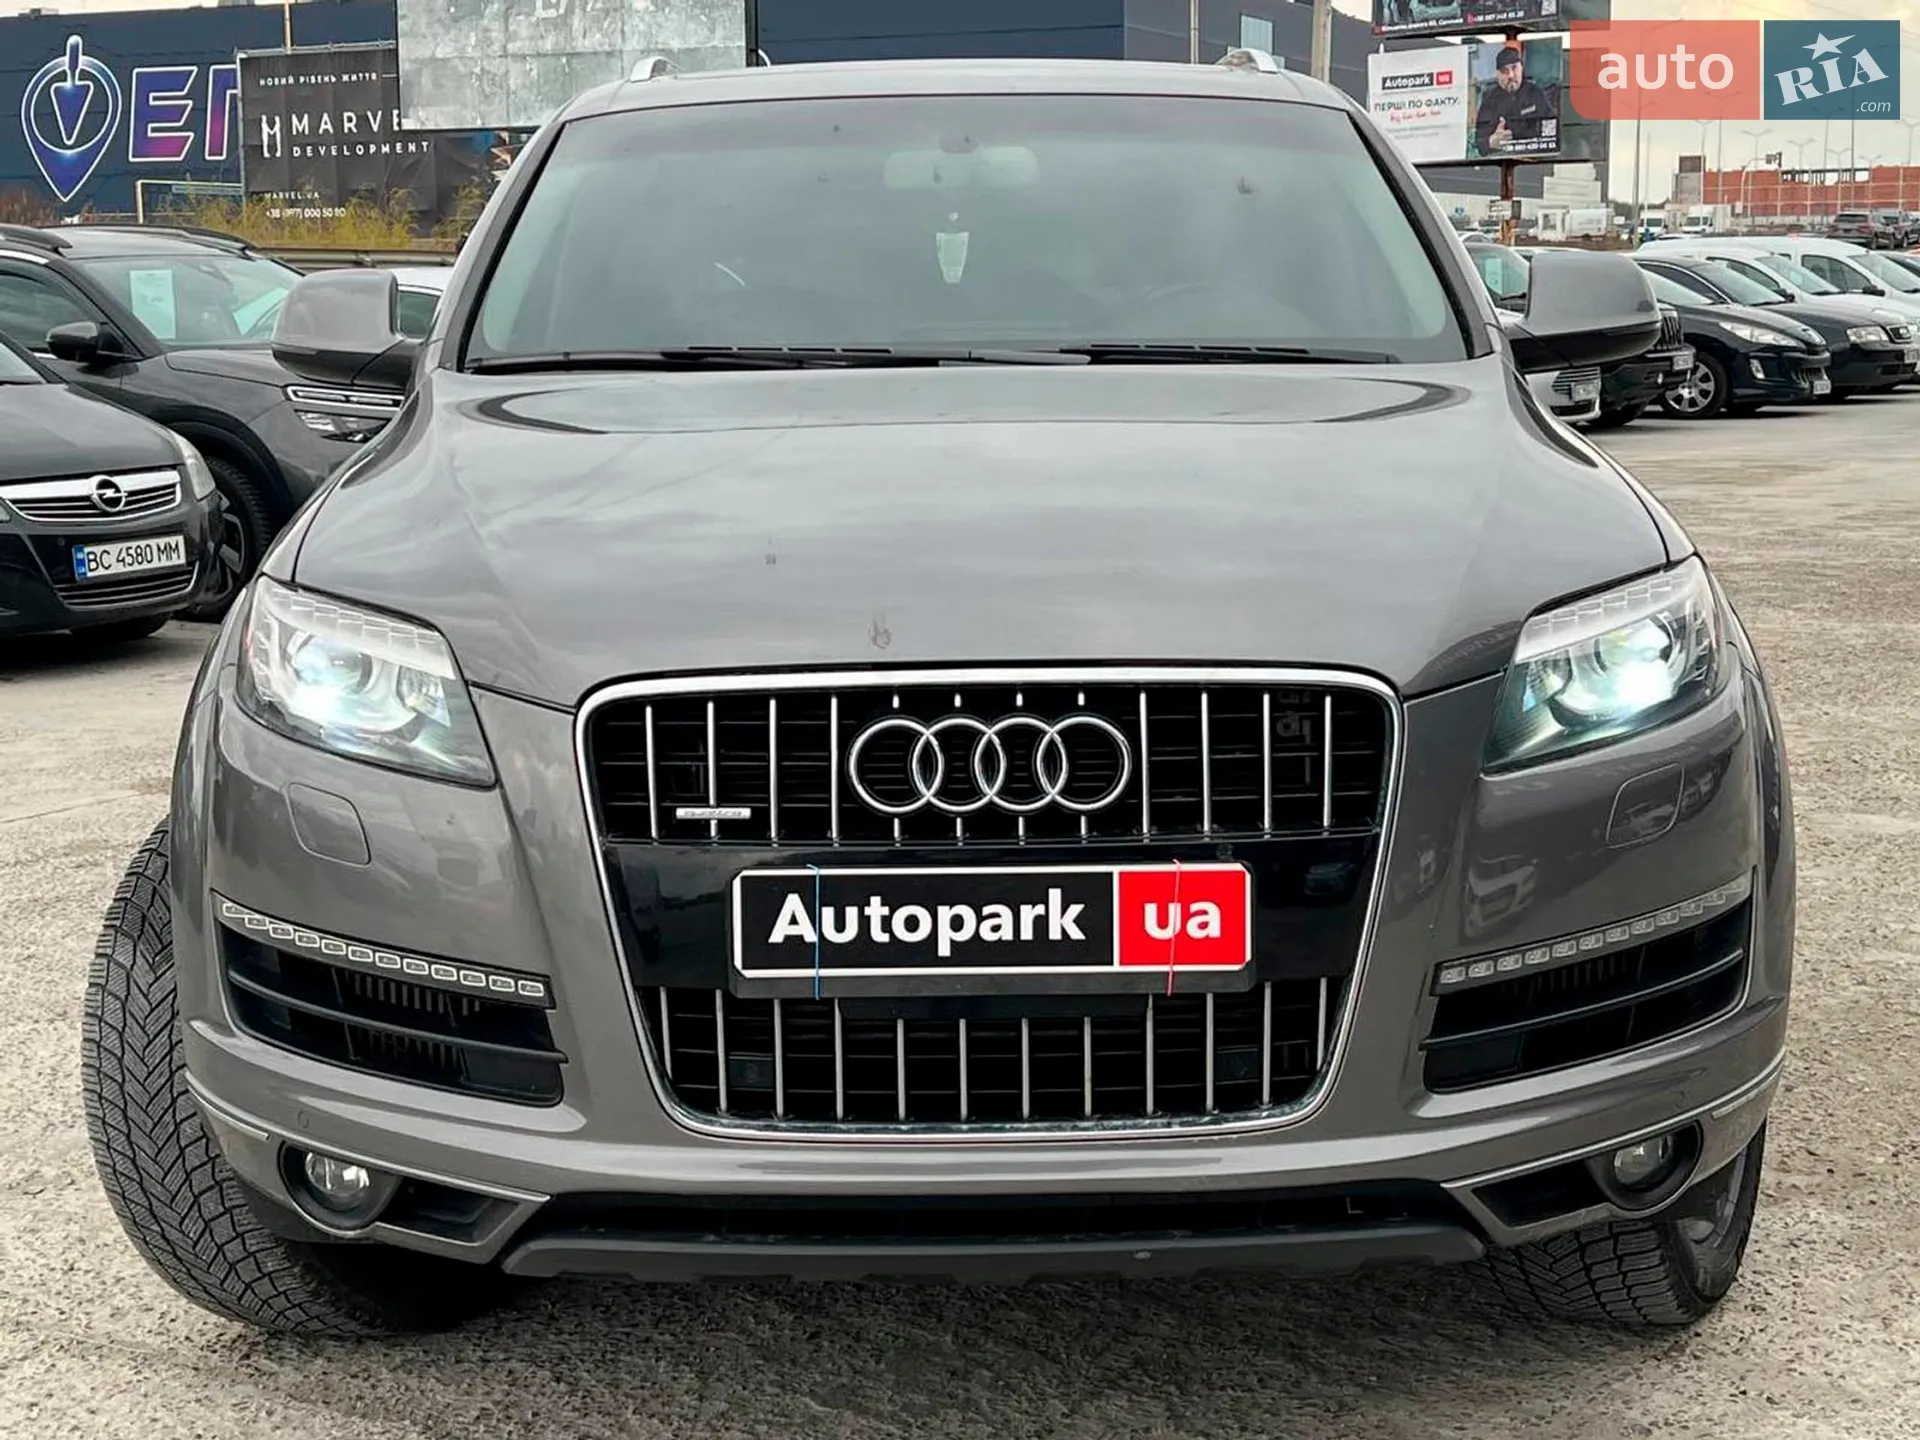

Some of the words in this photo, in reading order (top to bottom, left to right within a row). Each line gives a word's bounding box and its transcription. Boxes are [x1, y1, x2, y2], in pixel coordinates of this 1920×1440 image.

[1384, 74, 1432, 88] Autopark
[1408, 100, 1423, 109] ПО
[293, 141, 430, 157] DEVELOPMENT
[304, 207, 321, 218] 000
[86, 549, 112, 572] BC
[116, 543, 153, 568] 4580
[156, 540, 181, 562] MM
[768, 888, 1086, 957] Autopark
[1144, 900, 1221, 939] ua
